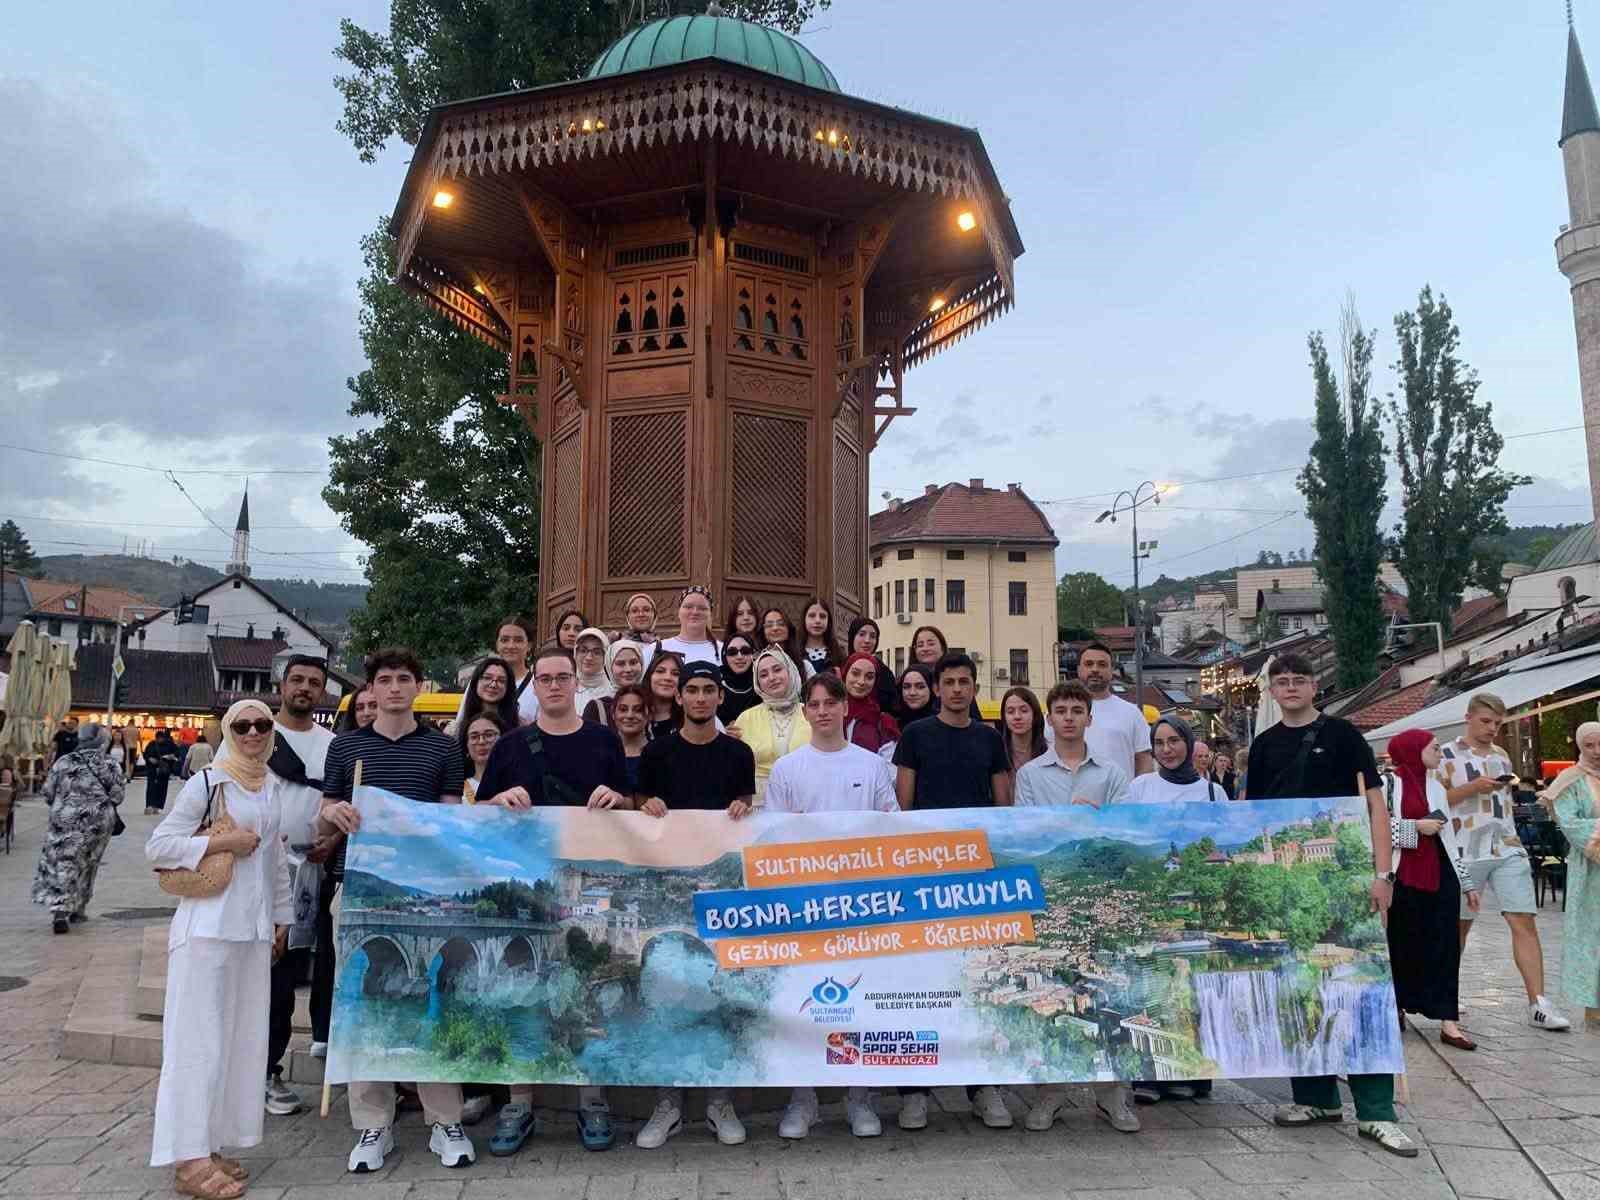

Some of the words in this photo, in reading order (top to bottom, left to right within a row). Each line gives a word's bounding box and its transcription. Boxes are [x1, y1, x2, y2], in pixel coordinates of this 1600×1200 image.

[754, 846, 884, 876] SULTANGAZİLİ
[892, 843, 982, 869] GENÇLER
[705, 890, 905, 930] BOSNA-HERSEK
[913, 878, 1033, 910] TURUYLA
[727, 940, 803, 964] GEZİYOR
[823, 931, 904, 957] GÖRÜYOR
[924, 920, 1025, 946] ÖĞRENİYOR
[863, 1043, 897, 1054] SPOR
[864, 1031, 914, 1042] AVRUPA
